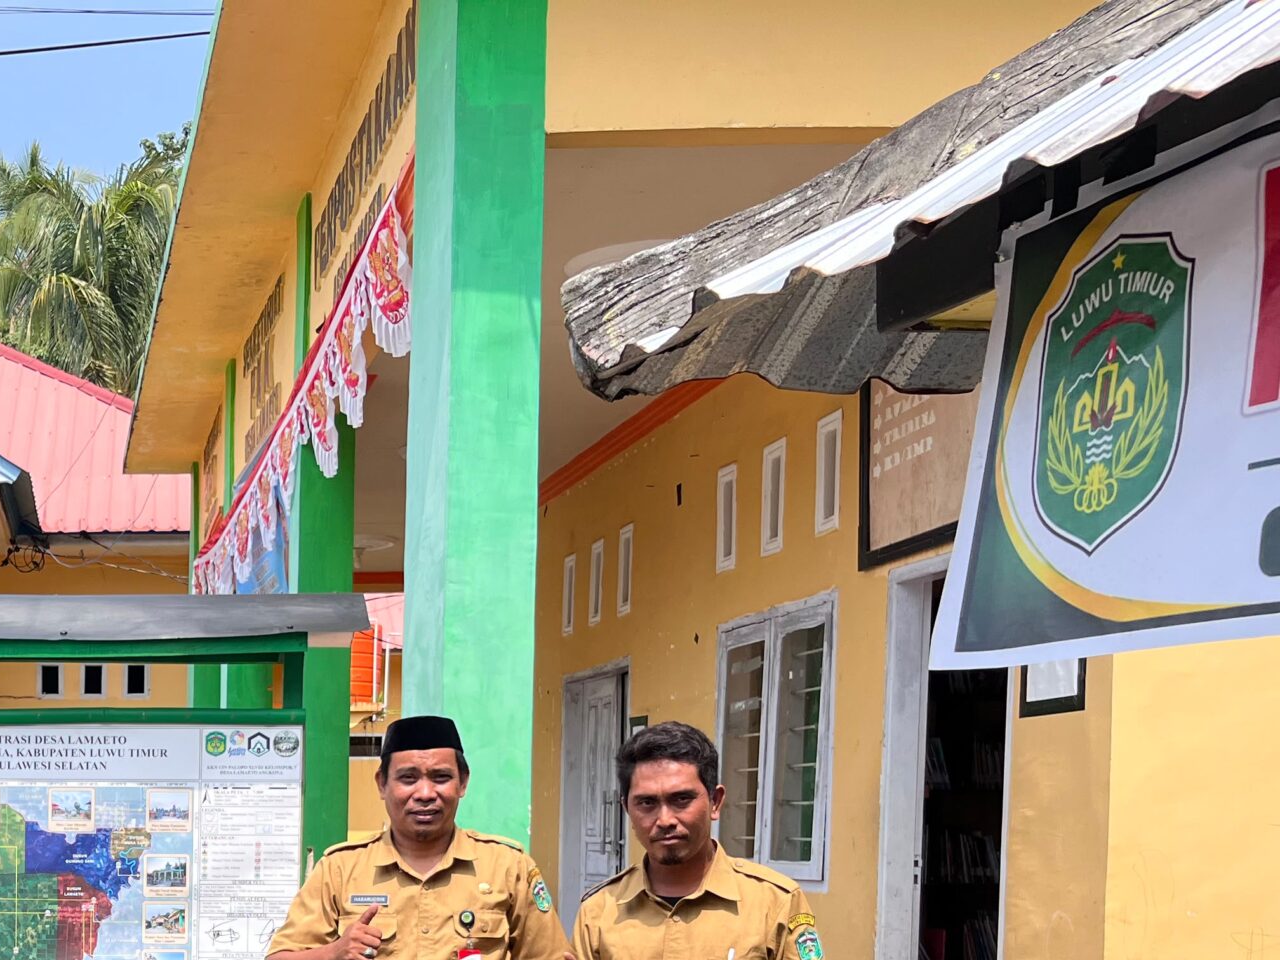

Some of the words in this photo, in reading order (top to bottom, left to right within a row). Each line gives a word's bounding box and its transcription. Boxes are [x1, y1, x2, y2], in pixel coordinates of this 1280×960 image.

[1060, 279, 1112, 342] LUWU
[34, 735, 65, 745] DESA
[67, 735, 127, 745] LAMAETO
[16, 748, 87, 758] KABUPATEN
[89, 748, 126, 758] LUWU
[128, 748, 168, 758] TIMUR
[54, 760, 108, 771] SELATAN
